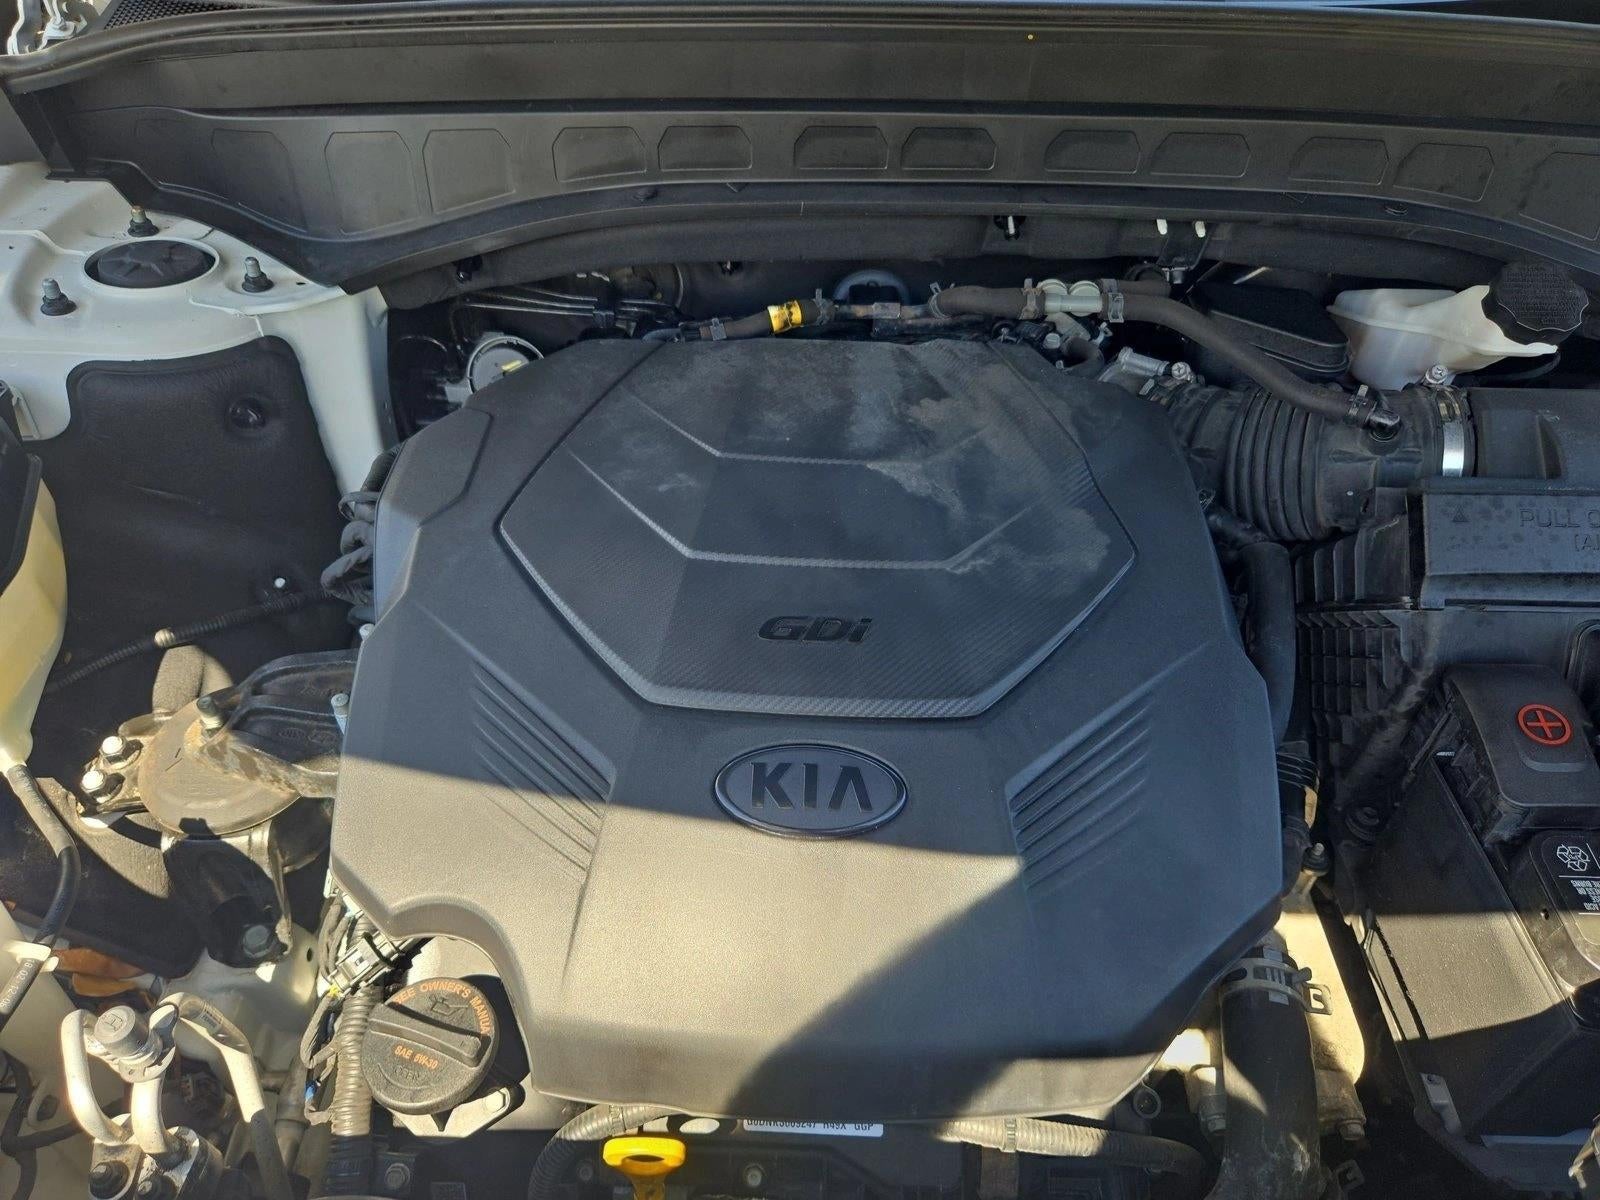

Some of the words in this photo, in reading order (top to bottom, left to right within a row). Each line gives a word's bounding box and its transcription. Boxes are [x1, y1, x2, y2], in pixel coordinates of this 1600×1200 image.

[1520, 508, 1580, 528] PULL
[750, 761, 874, 813] KIA
[420, 981, 472, 998] OWNER'S
[469, 996, 492, 1035] MANUA
[394, 1045, 413, 1059] SAE
